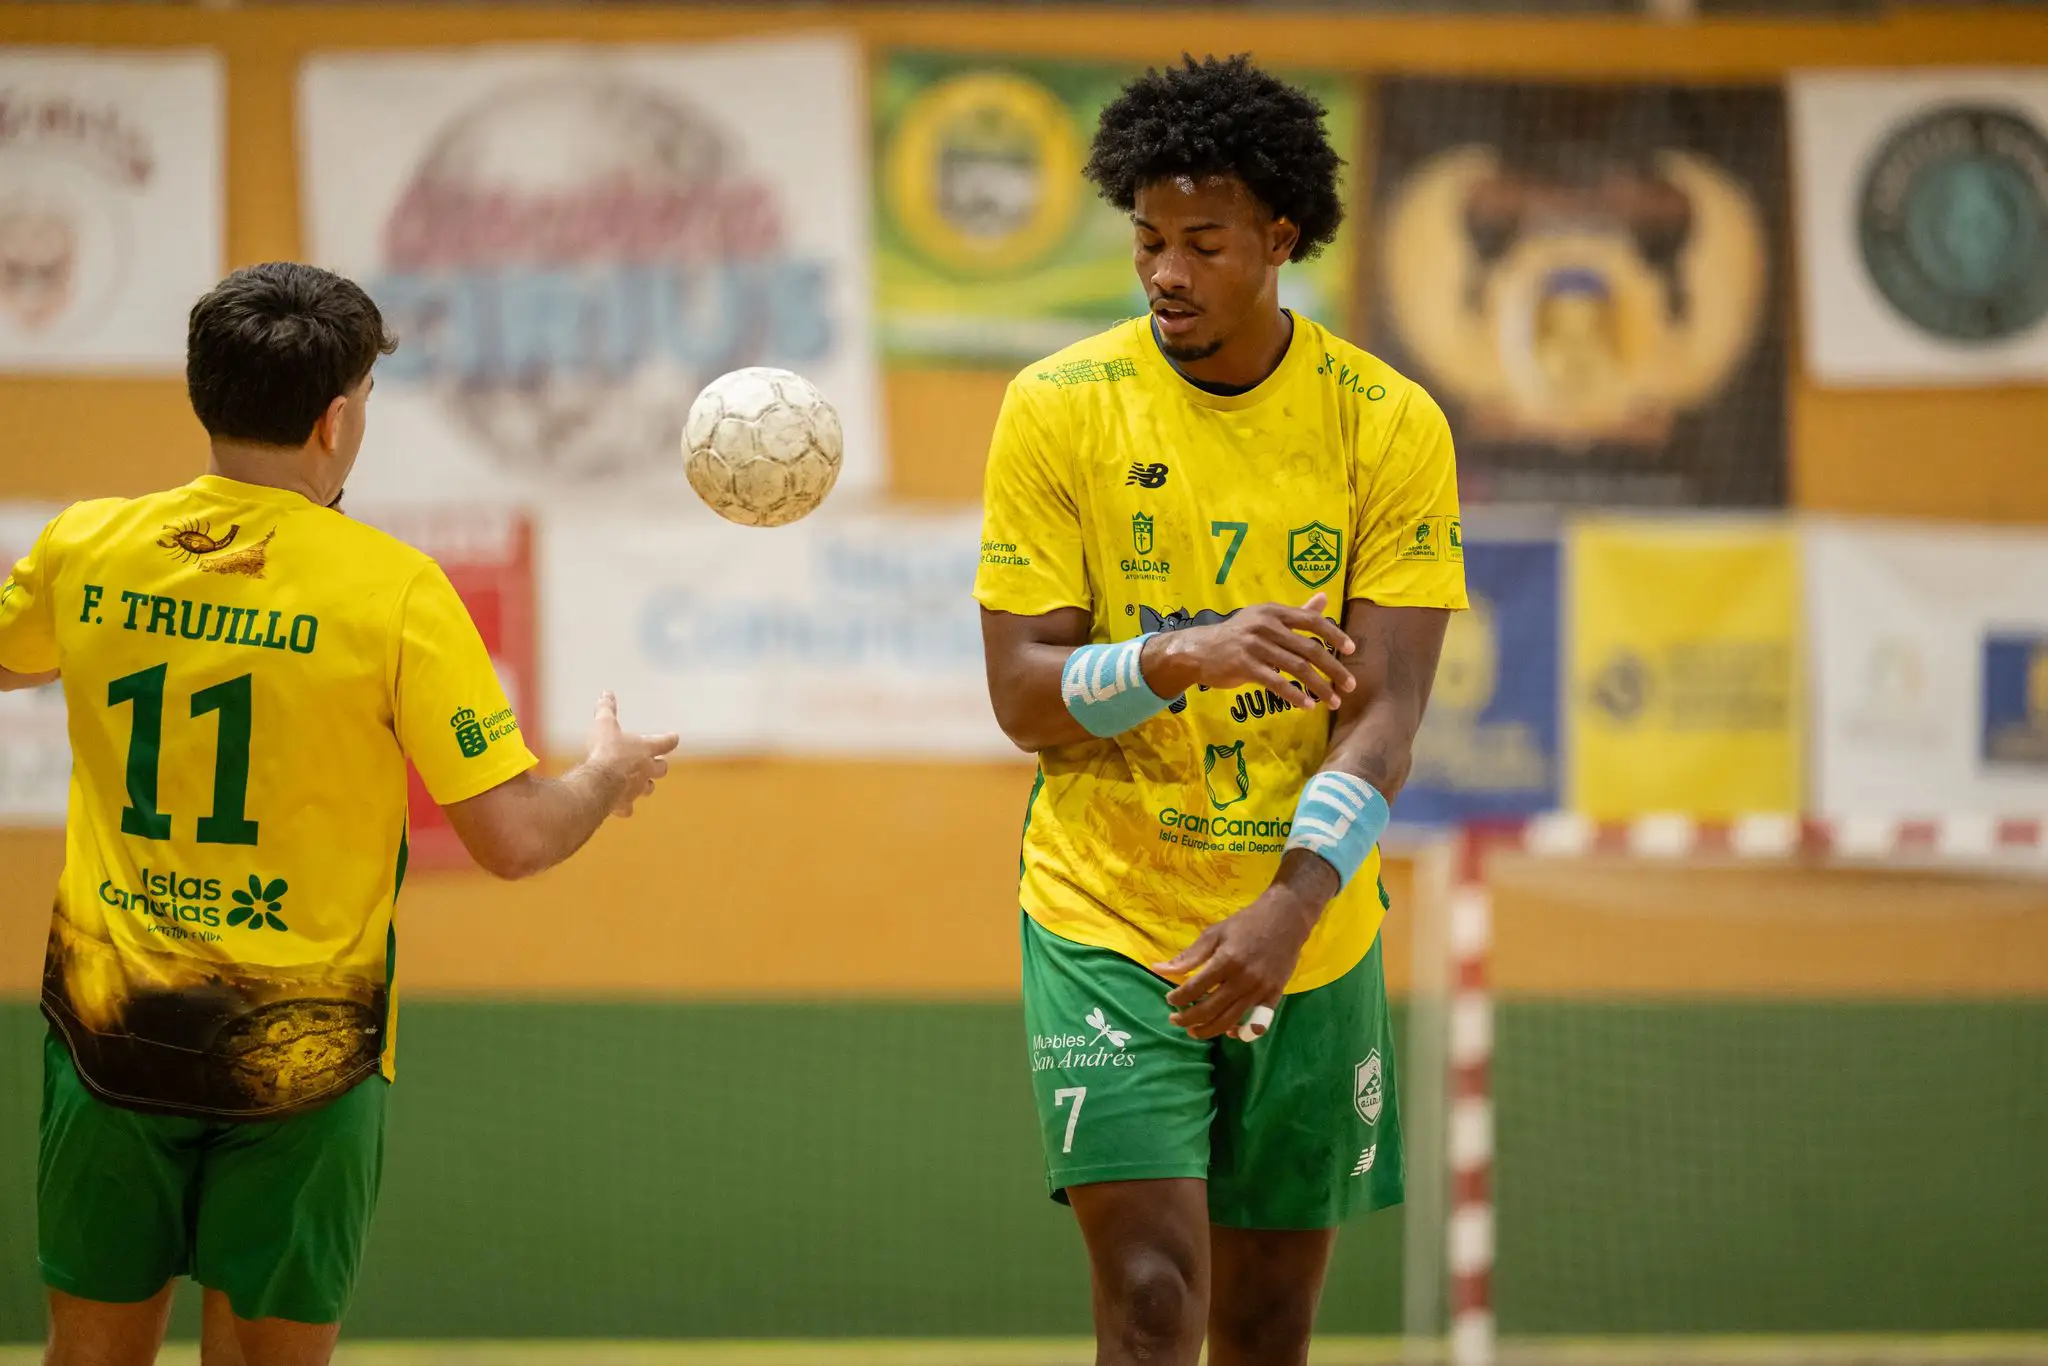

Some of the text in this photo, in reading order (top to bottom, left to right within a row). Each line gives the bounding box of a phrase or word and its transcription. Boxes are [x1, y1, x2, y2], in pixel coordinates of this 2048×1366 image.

[1211, 520, 1248, 585] 7
[79, 584, 319, 654] F. TRUJILLO
[482, 707, 513, 729] Gobiern
[107, 661, 259, 847] 11
[1159, 828, 1178, 844] Isla
[1181, 834, 1225, 852] Europea
[1228, 840, 1246, 852] del
[99, 879, 221, 928] Canarias
[142, 868, 221, 901] Islas
[1032, 1046, 1137, 1072] San Andrés
[1033, 1033, 1086, 1051] Muebles
[1054, 1086, 1087, 1154] 7
